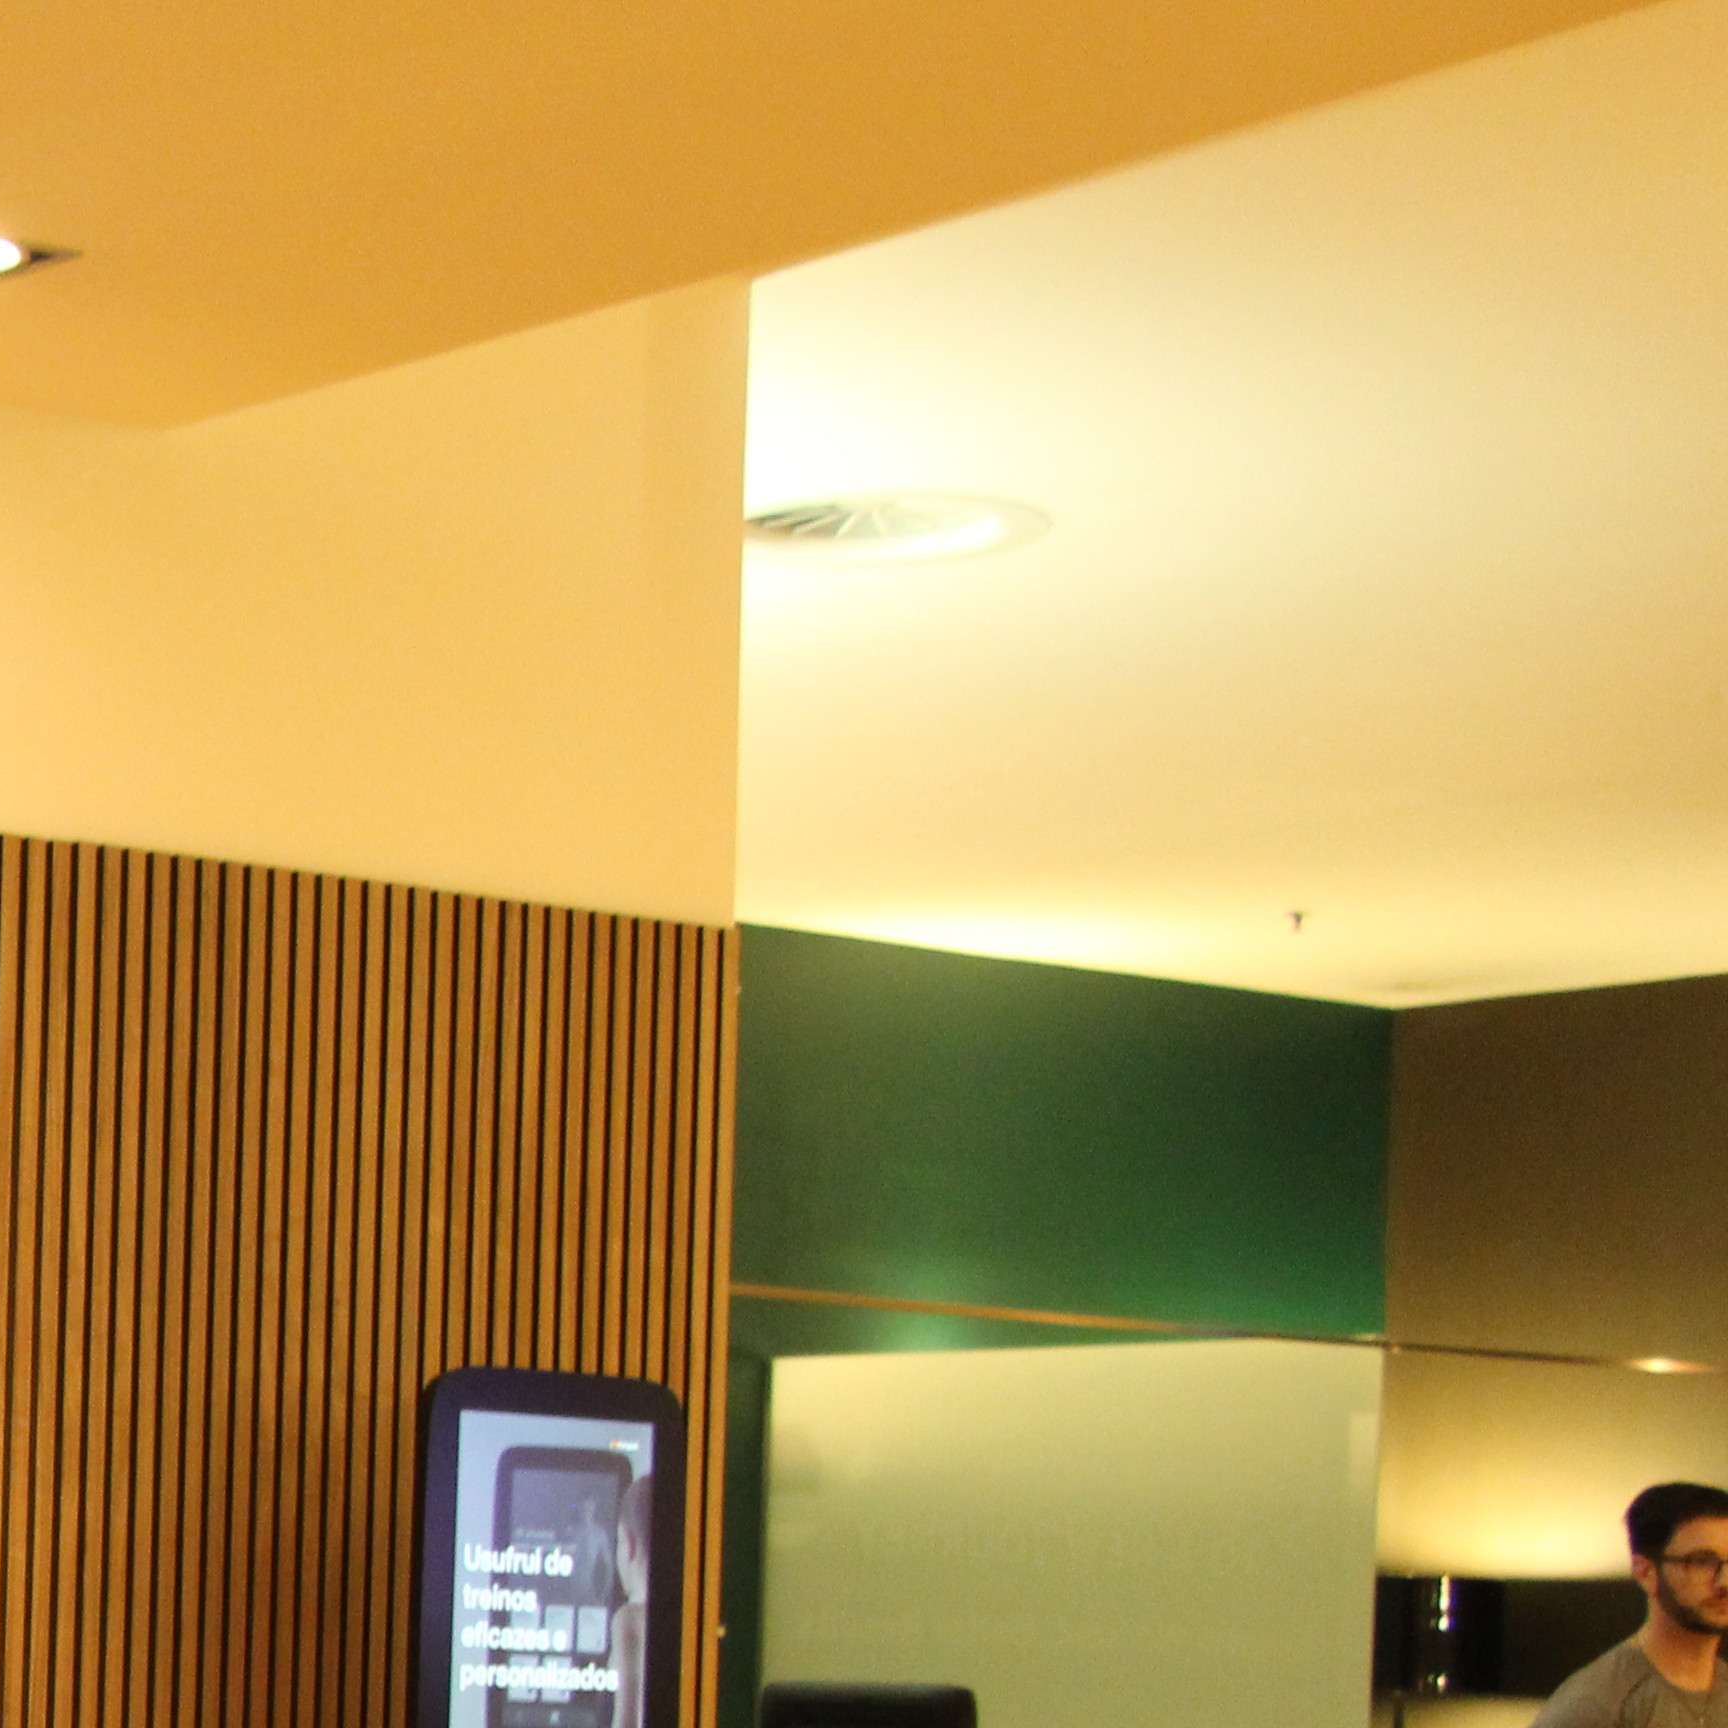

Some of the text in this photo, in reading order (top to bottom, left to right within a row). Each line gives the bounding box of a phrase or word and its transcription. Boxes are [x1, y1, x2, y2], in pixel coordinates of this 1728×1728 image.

[462, 1543, 574, 1577] Usufrui de
[462, 1582, 538, 1613] treinos
[460, 1621, 549, 1651] eficazes
[459, 1660, 620, 1692] personalizados
